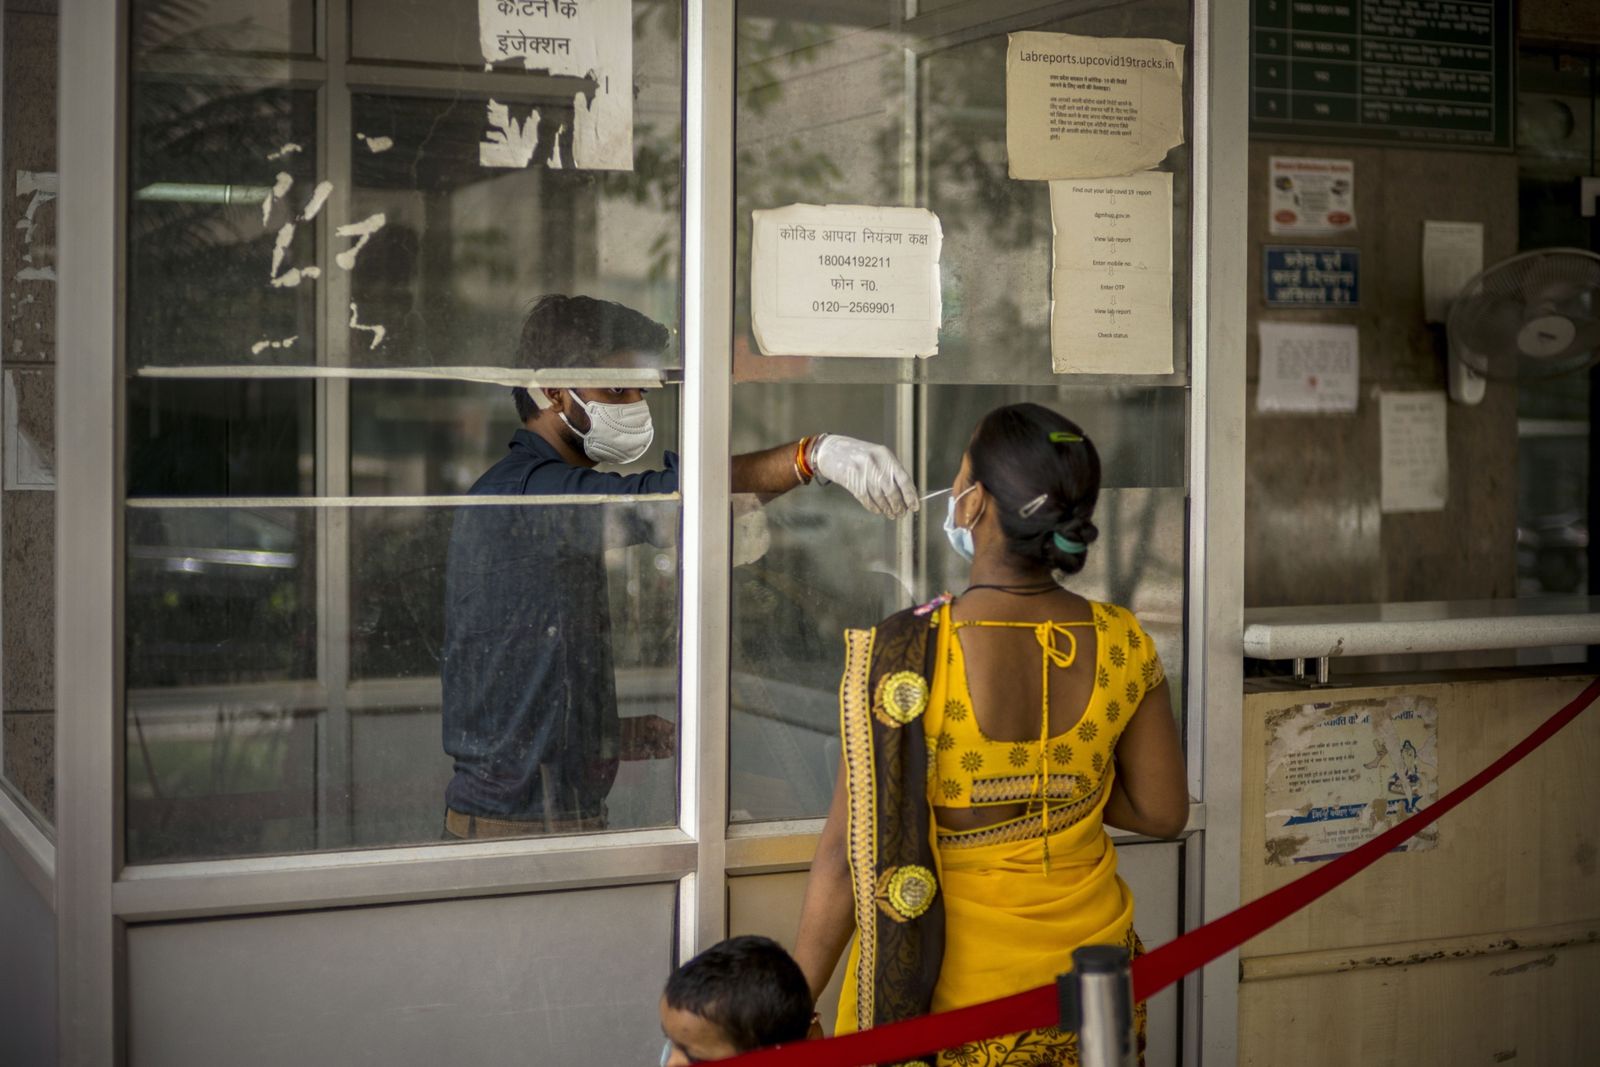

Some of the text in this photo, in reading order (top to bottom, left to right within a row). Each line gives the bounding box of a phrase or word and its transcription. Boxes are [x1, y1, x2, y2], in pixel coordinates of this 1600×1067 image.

[496, 29, 571, 55] इंजेक्शन
[1020, 50, 1175, 70] Labreports.upcovid19tracks.in
[779, 225, 928, 246] कोविड आपदा नियंत्रण कक्ष
[818, 255, 891, 268] 18004192211
[830, 274, 854, 291] फोन
